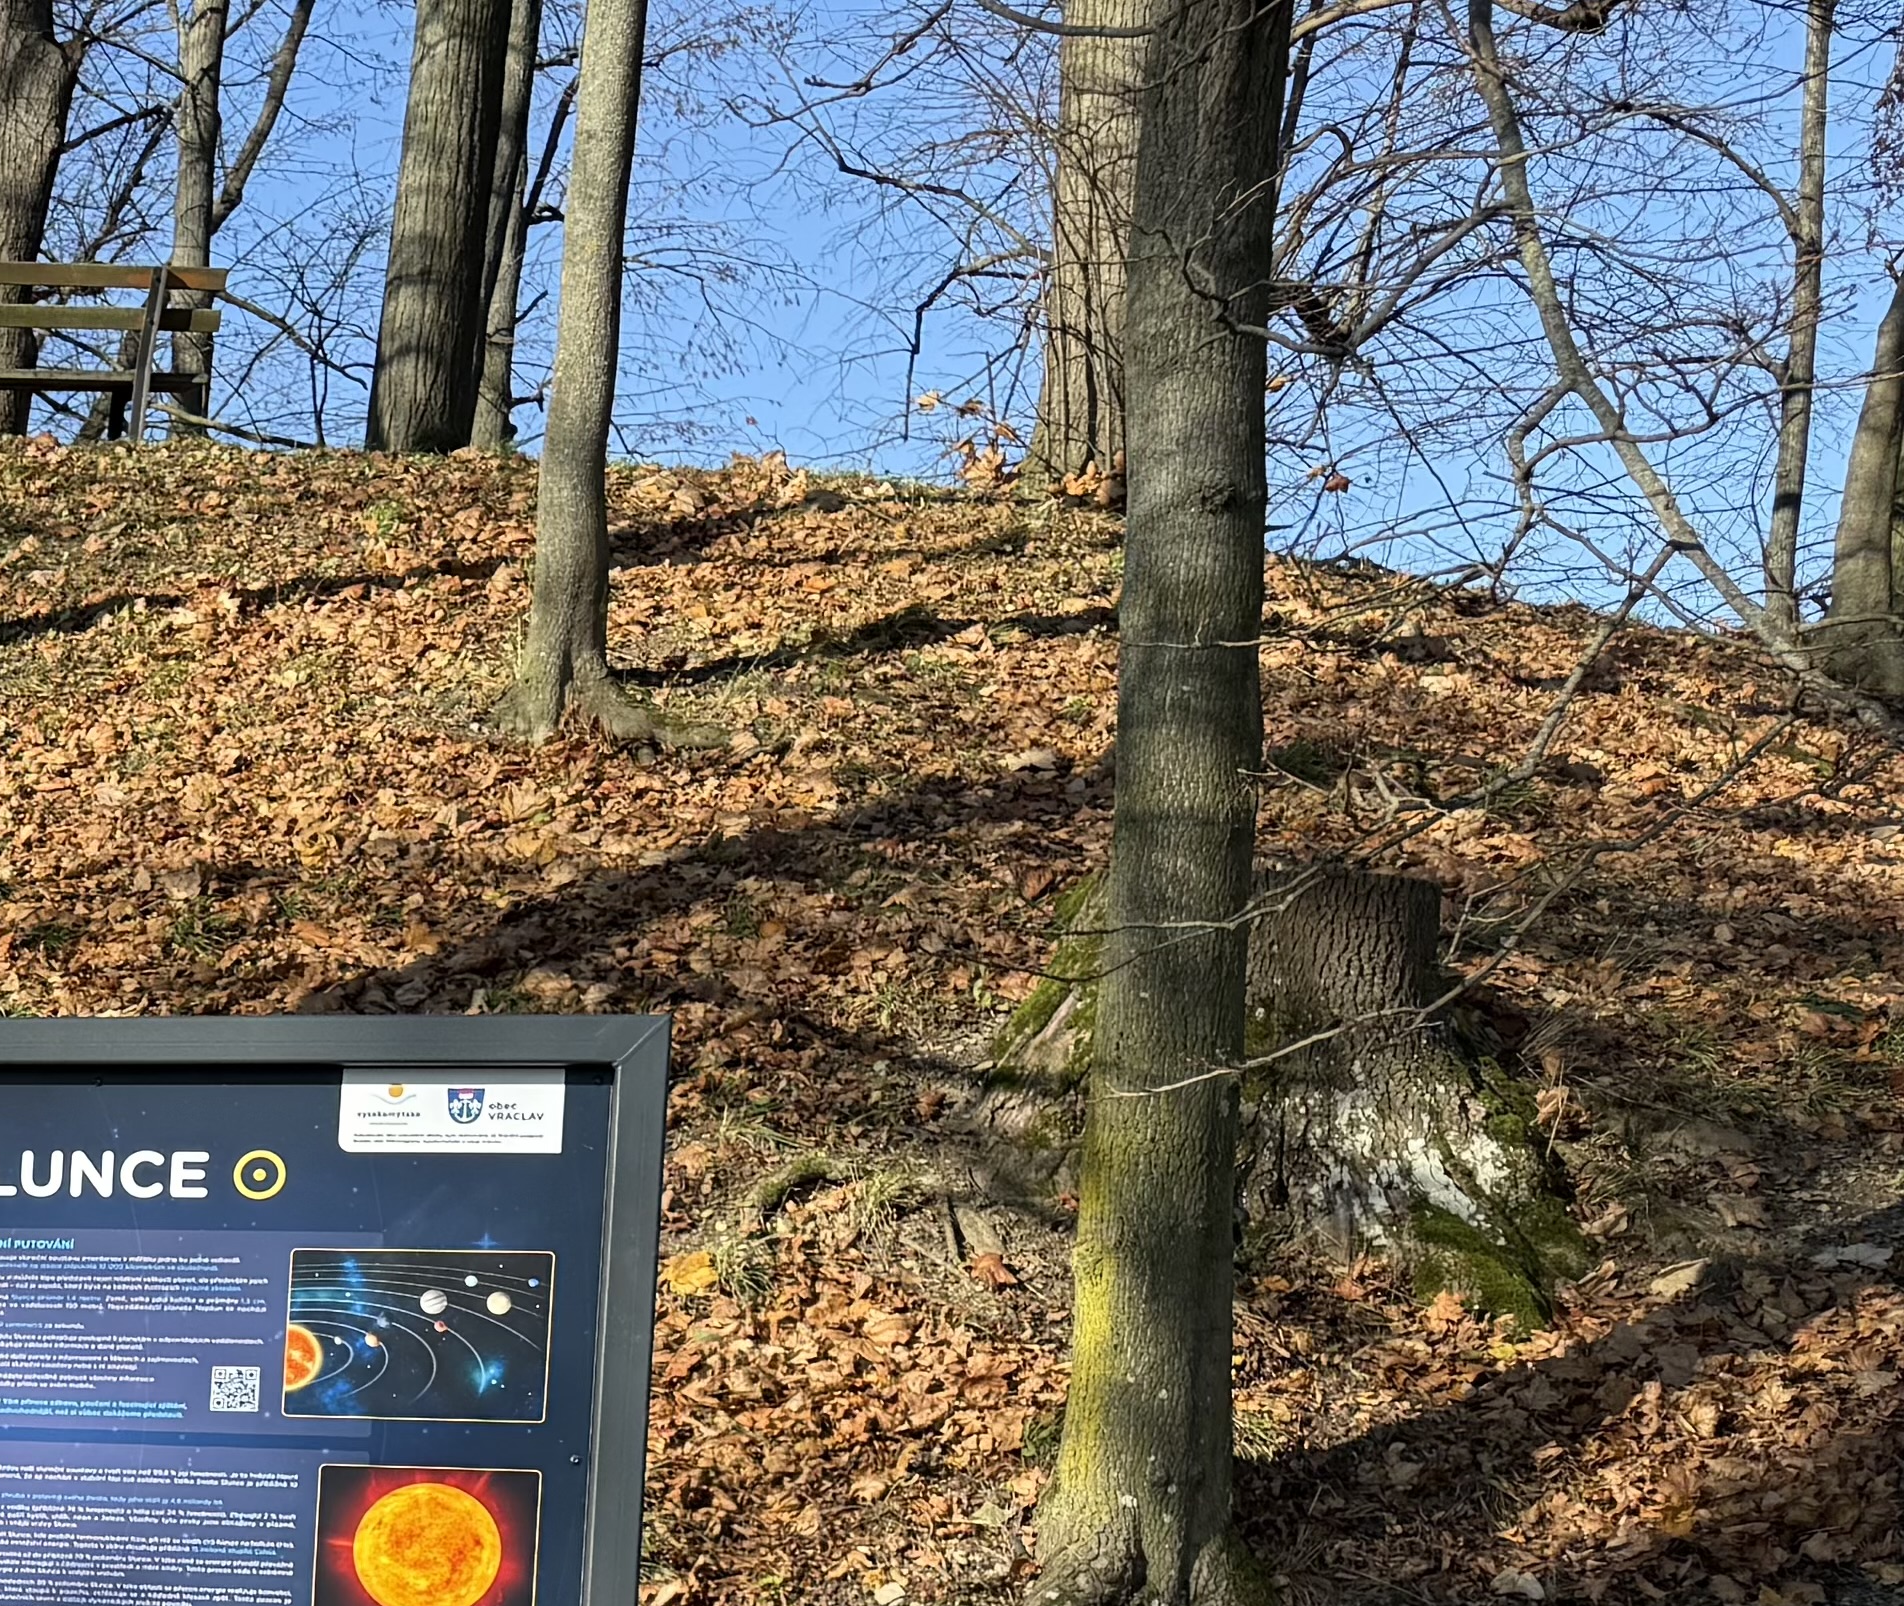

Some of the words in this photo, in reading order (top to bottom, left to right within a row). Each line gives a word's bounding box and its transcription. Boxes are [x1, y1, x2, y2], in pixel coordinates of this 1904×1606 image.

[488, 1102, 517, 1110] obec
[488, 1112, 544, 1121] VRACLAV
[14, 1239, 73, 1249] PUTOVÁNÍ
